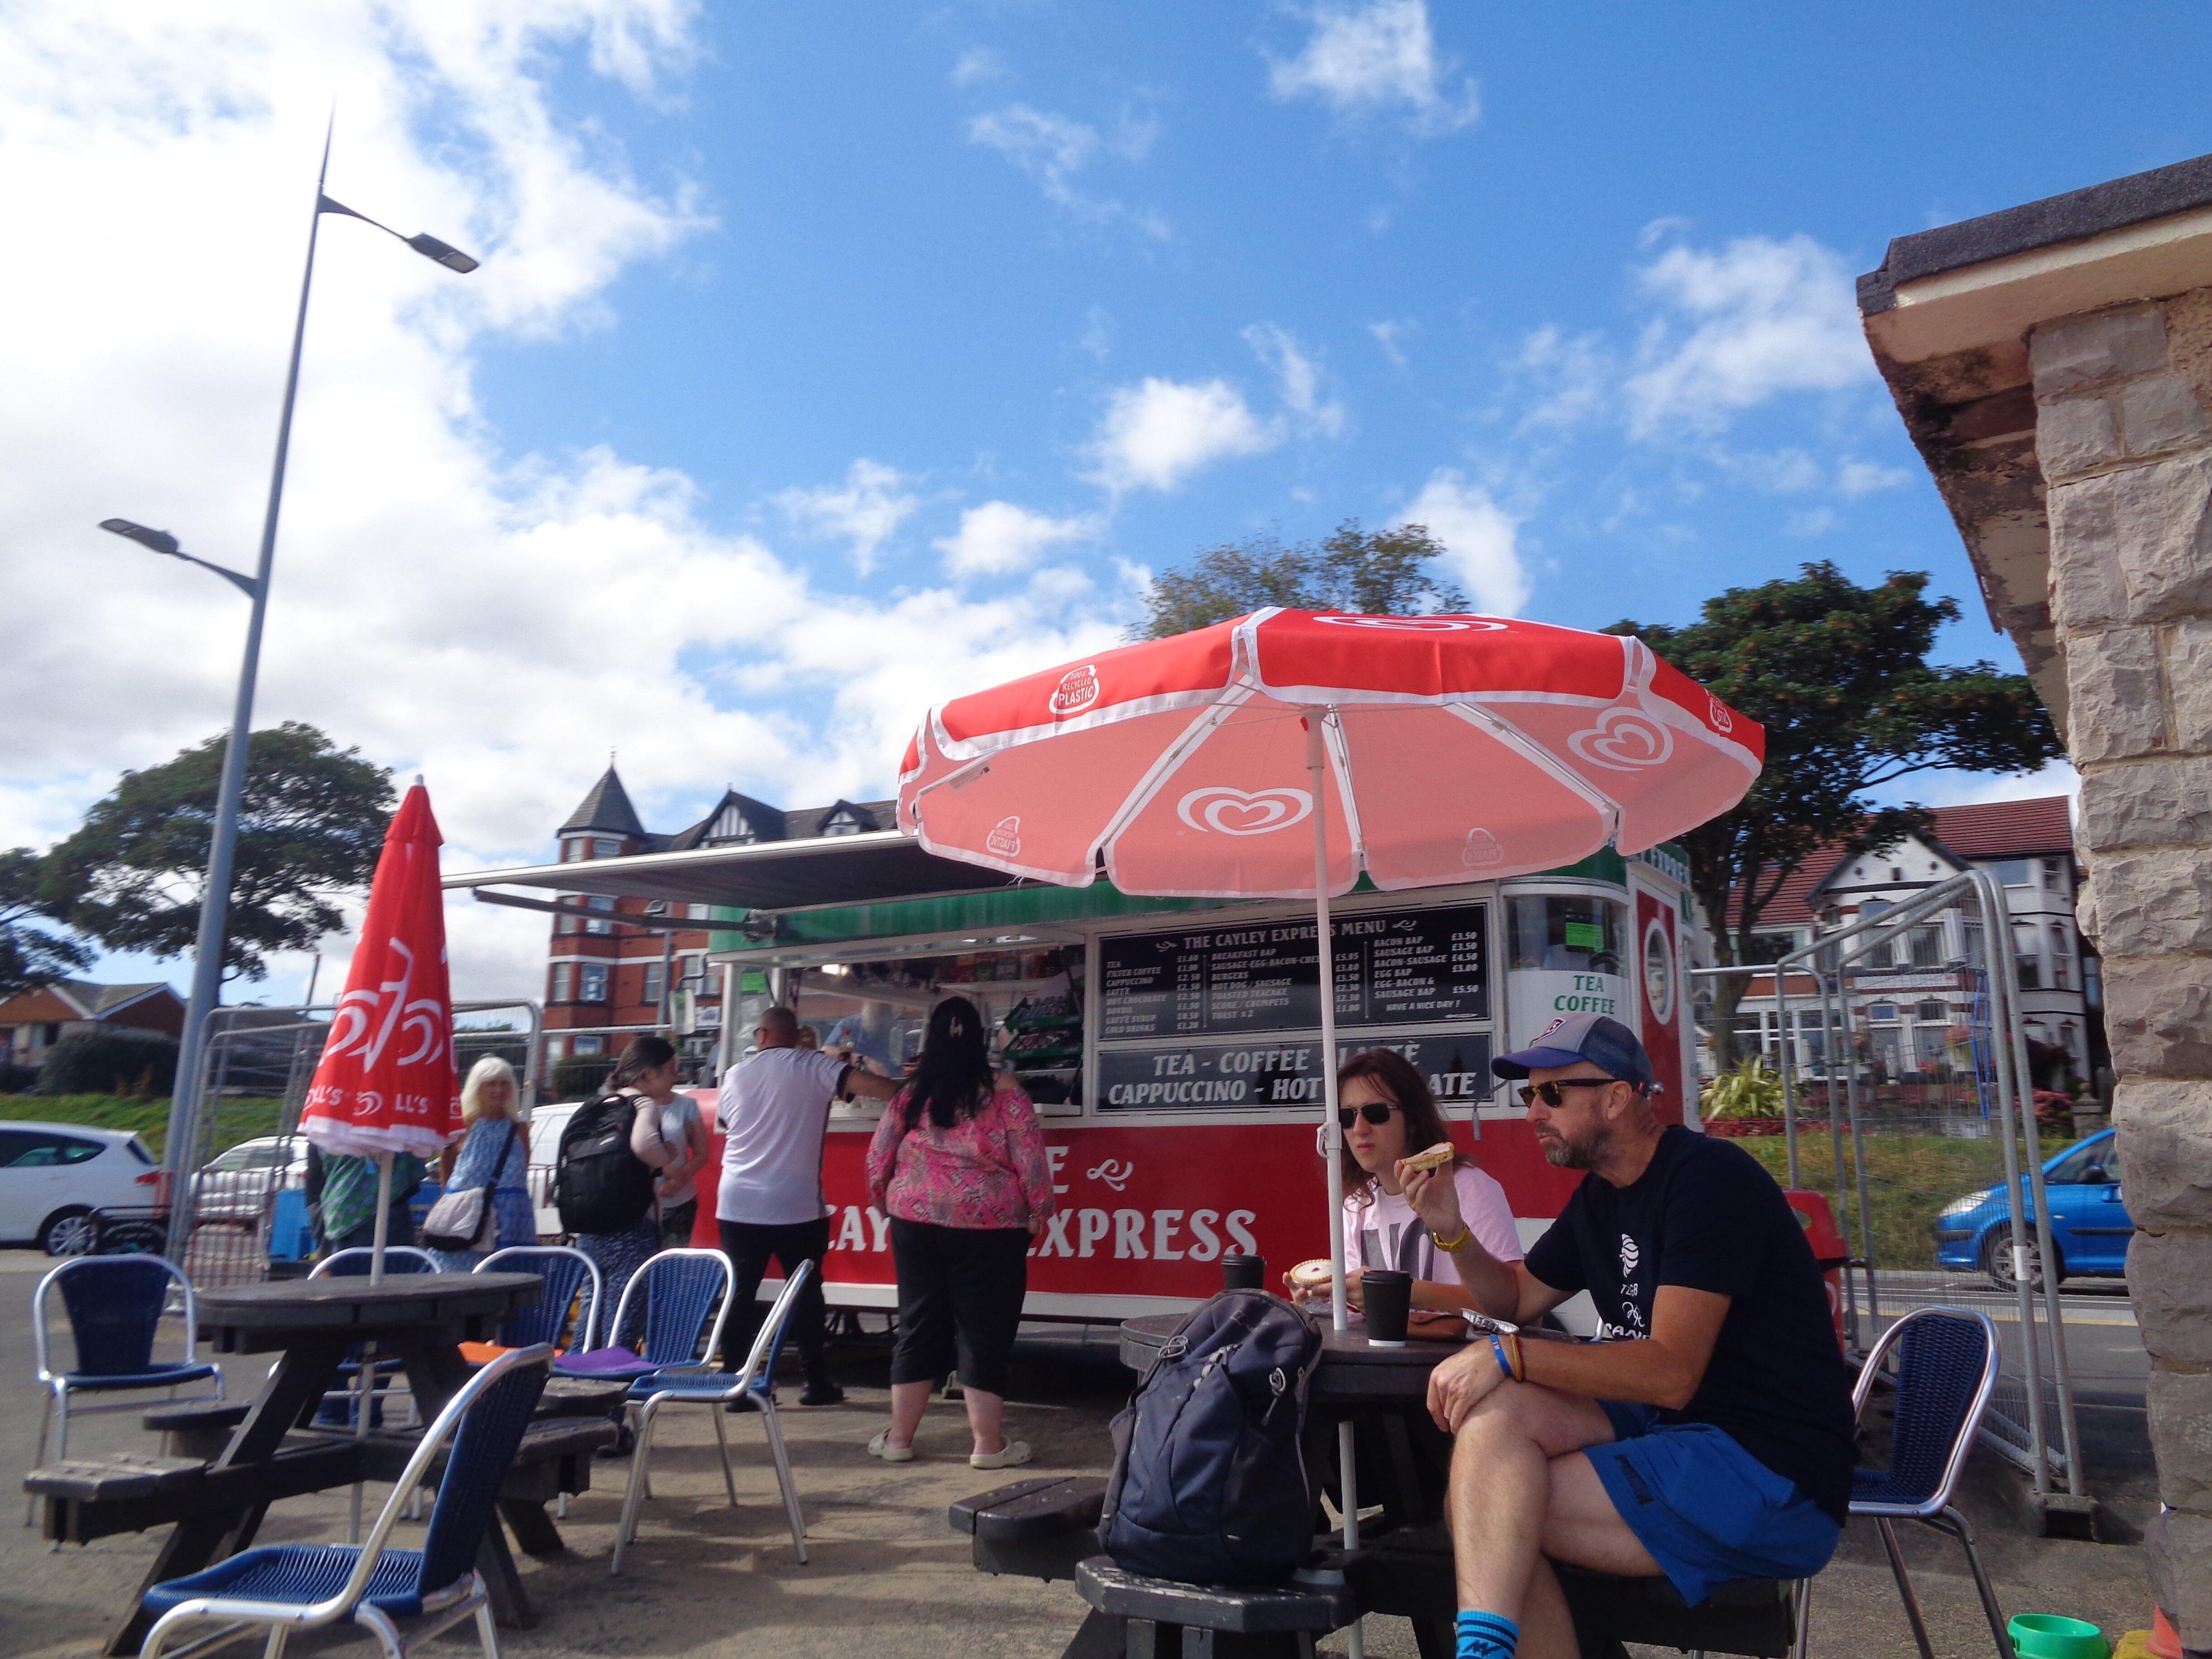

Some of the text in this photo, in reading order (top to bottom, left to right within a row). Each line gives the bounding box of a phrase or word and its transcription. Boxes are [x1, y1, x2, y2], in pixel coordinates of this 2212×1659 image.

[1063, 677, 1092, 691] RECYCLED
[1183, 920, 1387, 950] THE CAYLEY EXPRES MENU
[1374, 931, 1477, 948] BACON BAP £3.50
[1335, 952, 1359, 961] £5.95
[1374, 942, 1478, 957] SAUSAGE BAP £3.50
[1374, 952, 1478, 968] BACON-SAUSAGE £4.50
[1374, 964, 1479, 978] EGG BAP £3.00
[1375, 984, 1480, 999] SAUSAGE BAP £5.50
[1573, 975, 1605, 993] TEA
[1385, 1002, 1408, 1012] HAVE
[1408, 1002, 1415, 1010] A
[1416, 1001, 1436, 1010] NICE
[1437, 1000, 1455, 1008] DAY
[1553, 995, 1616, 1015] COFFEE
[1153, 1054, 1197, 1076] TEA
[1219, 1049, 1313, 1074] COFFEE
[1108, 1080, 1247, 1105] CAPPUCCINO
[1272, 1077, 1324, 1101] HOT
[1026, 1208, 1257, 1262] XPRESS
